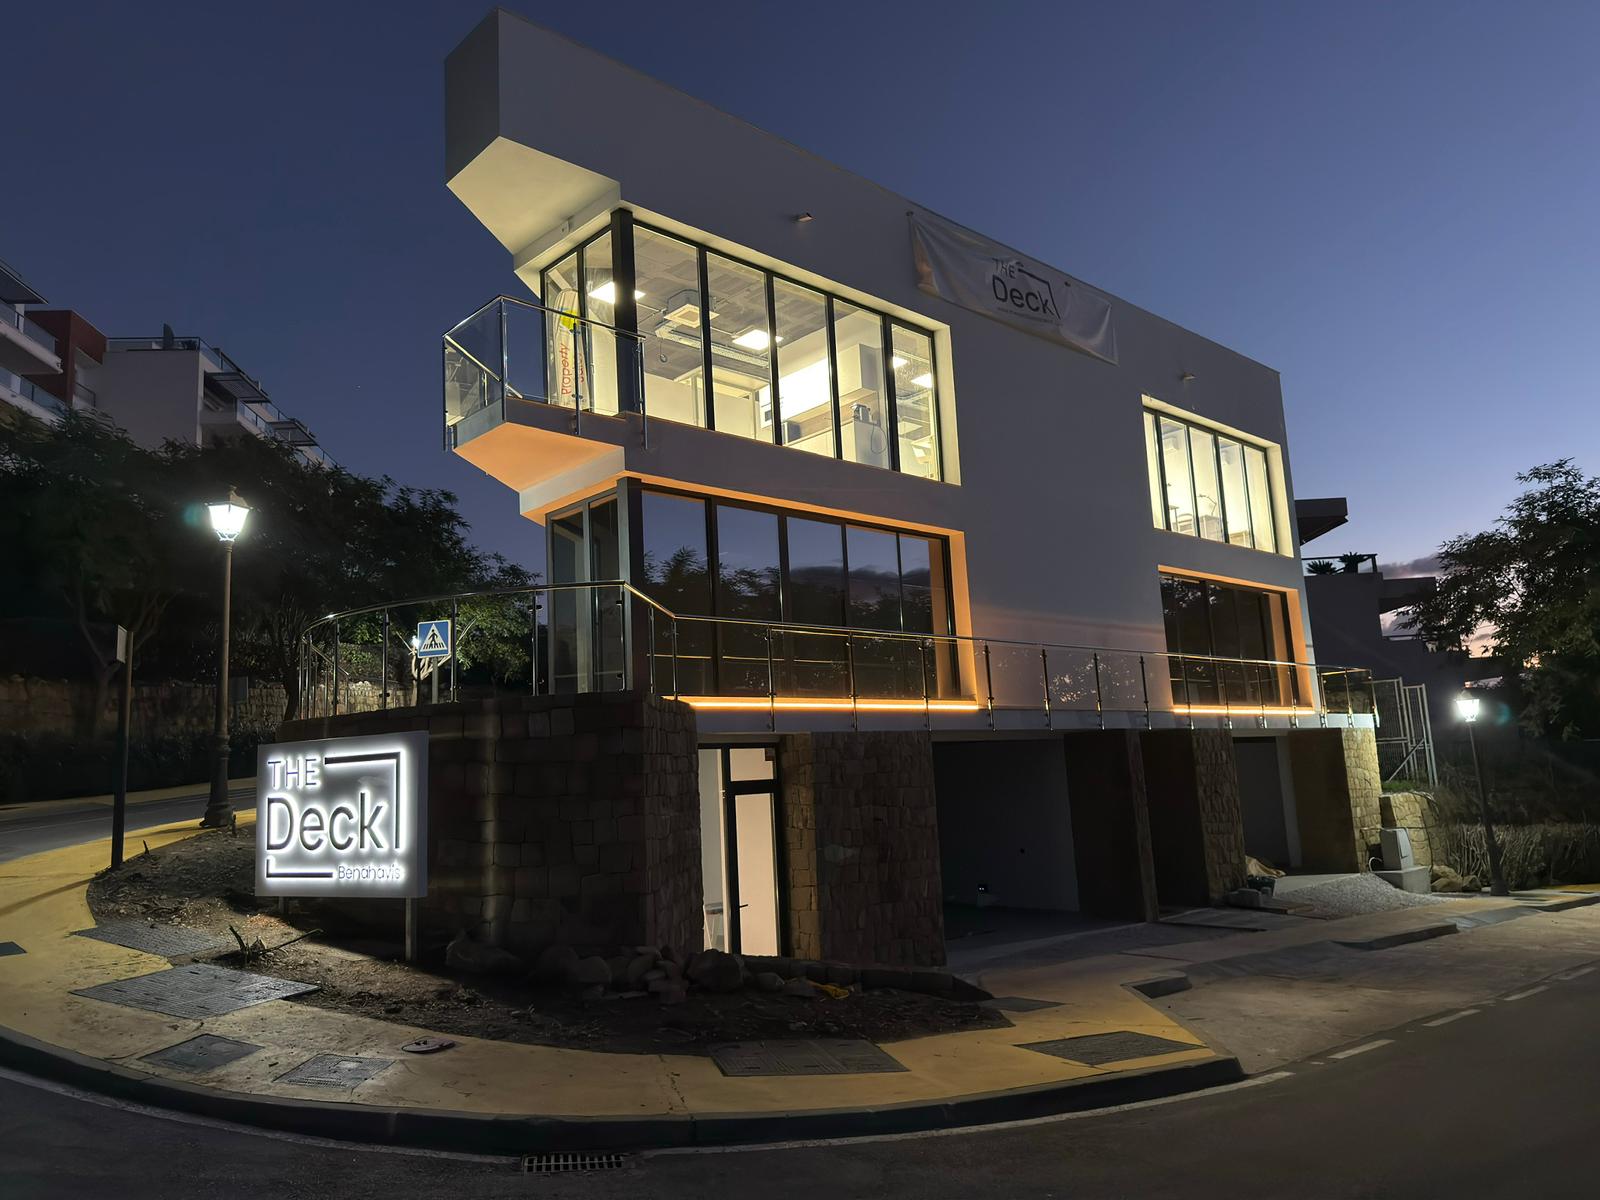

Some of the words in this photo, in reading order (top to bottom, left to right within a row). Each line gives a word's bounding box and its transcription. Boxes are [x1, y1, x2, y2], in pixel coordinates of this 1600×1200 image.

[992, 257, 1016, 279] THE
[992, 274, 1054, 316] Deck
[559, 343, 573, 395] Property
[267, 758, 317, 787] THE
[266, 792, 384, 851] Deck
